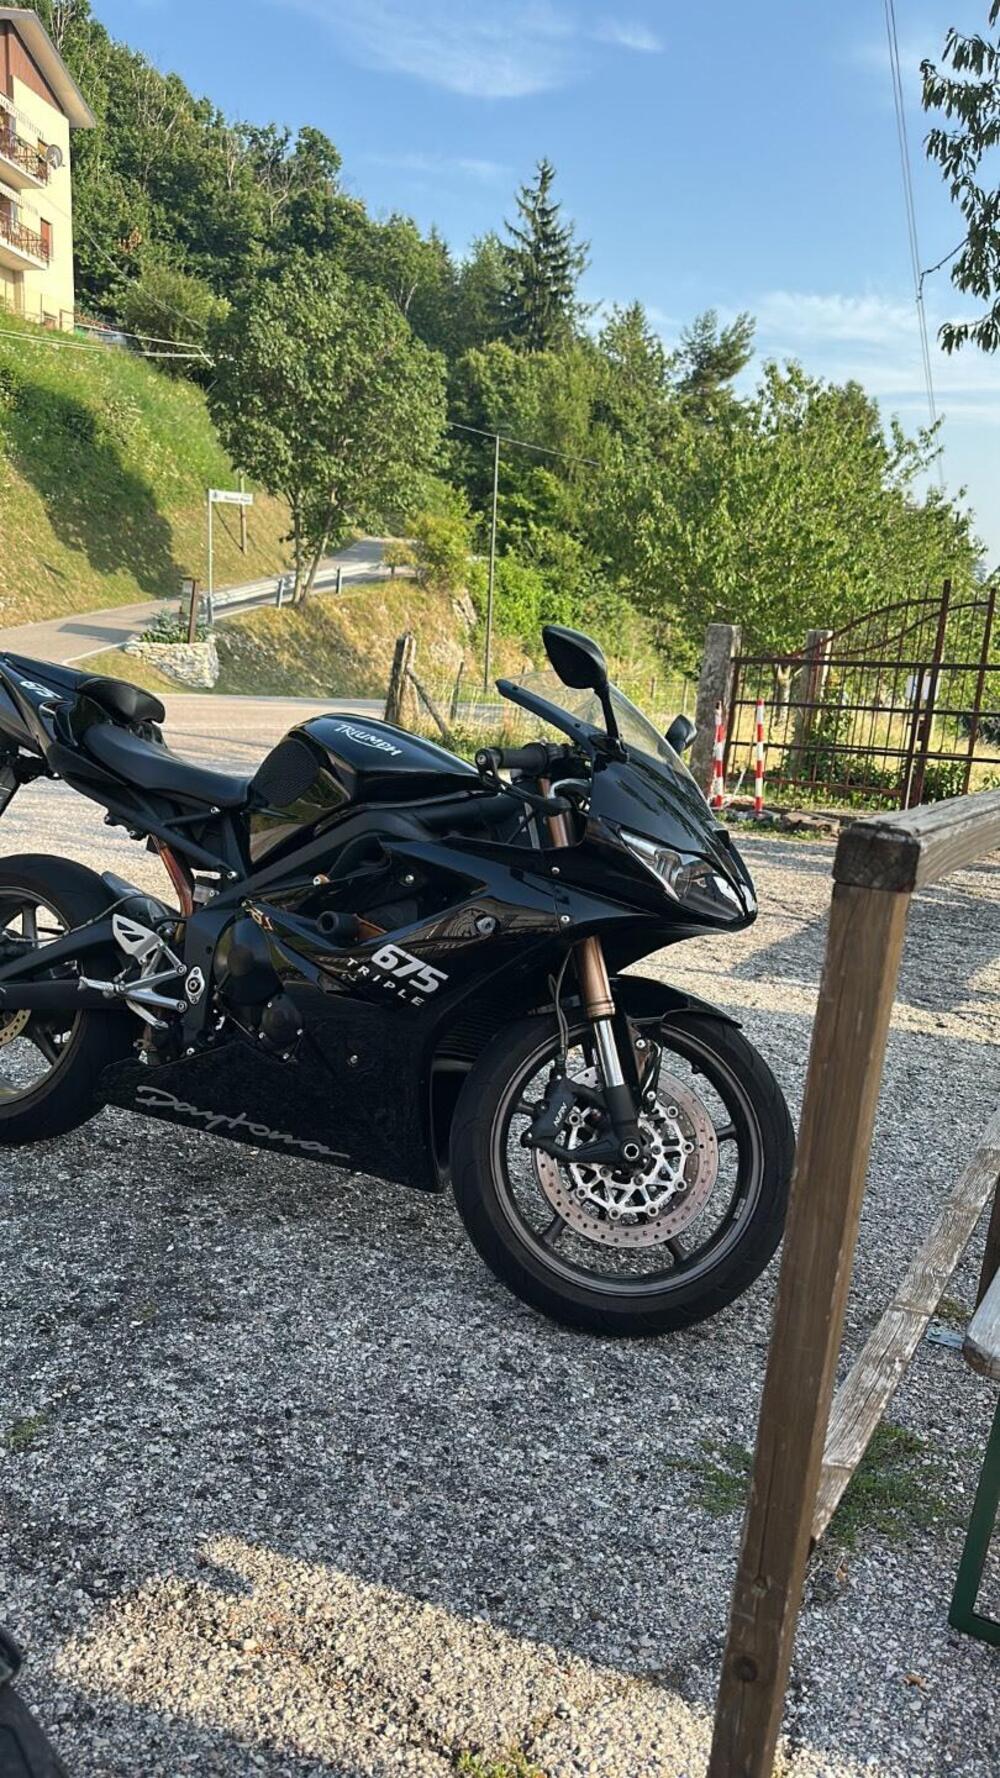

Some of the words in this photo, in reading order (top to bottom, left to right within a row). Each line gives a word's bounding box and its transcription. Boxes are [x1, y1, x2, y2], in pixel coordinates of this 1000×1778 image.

[20, 681, 63, 699] 675
[334, 724, 403, 756] TRIUMPH
[346, 957, 425, 1007] TRIPLE
[371, 943, 449, 993] 675
[135, 1085, 350, 1158] Daytona
